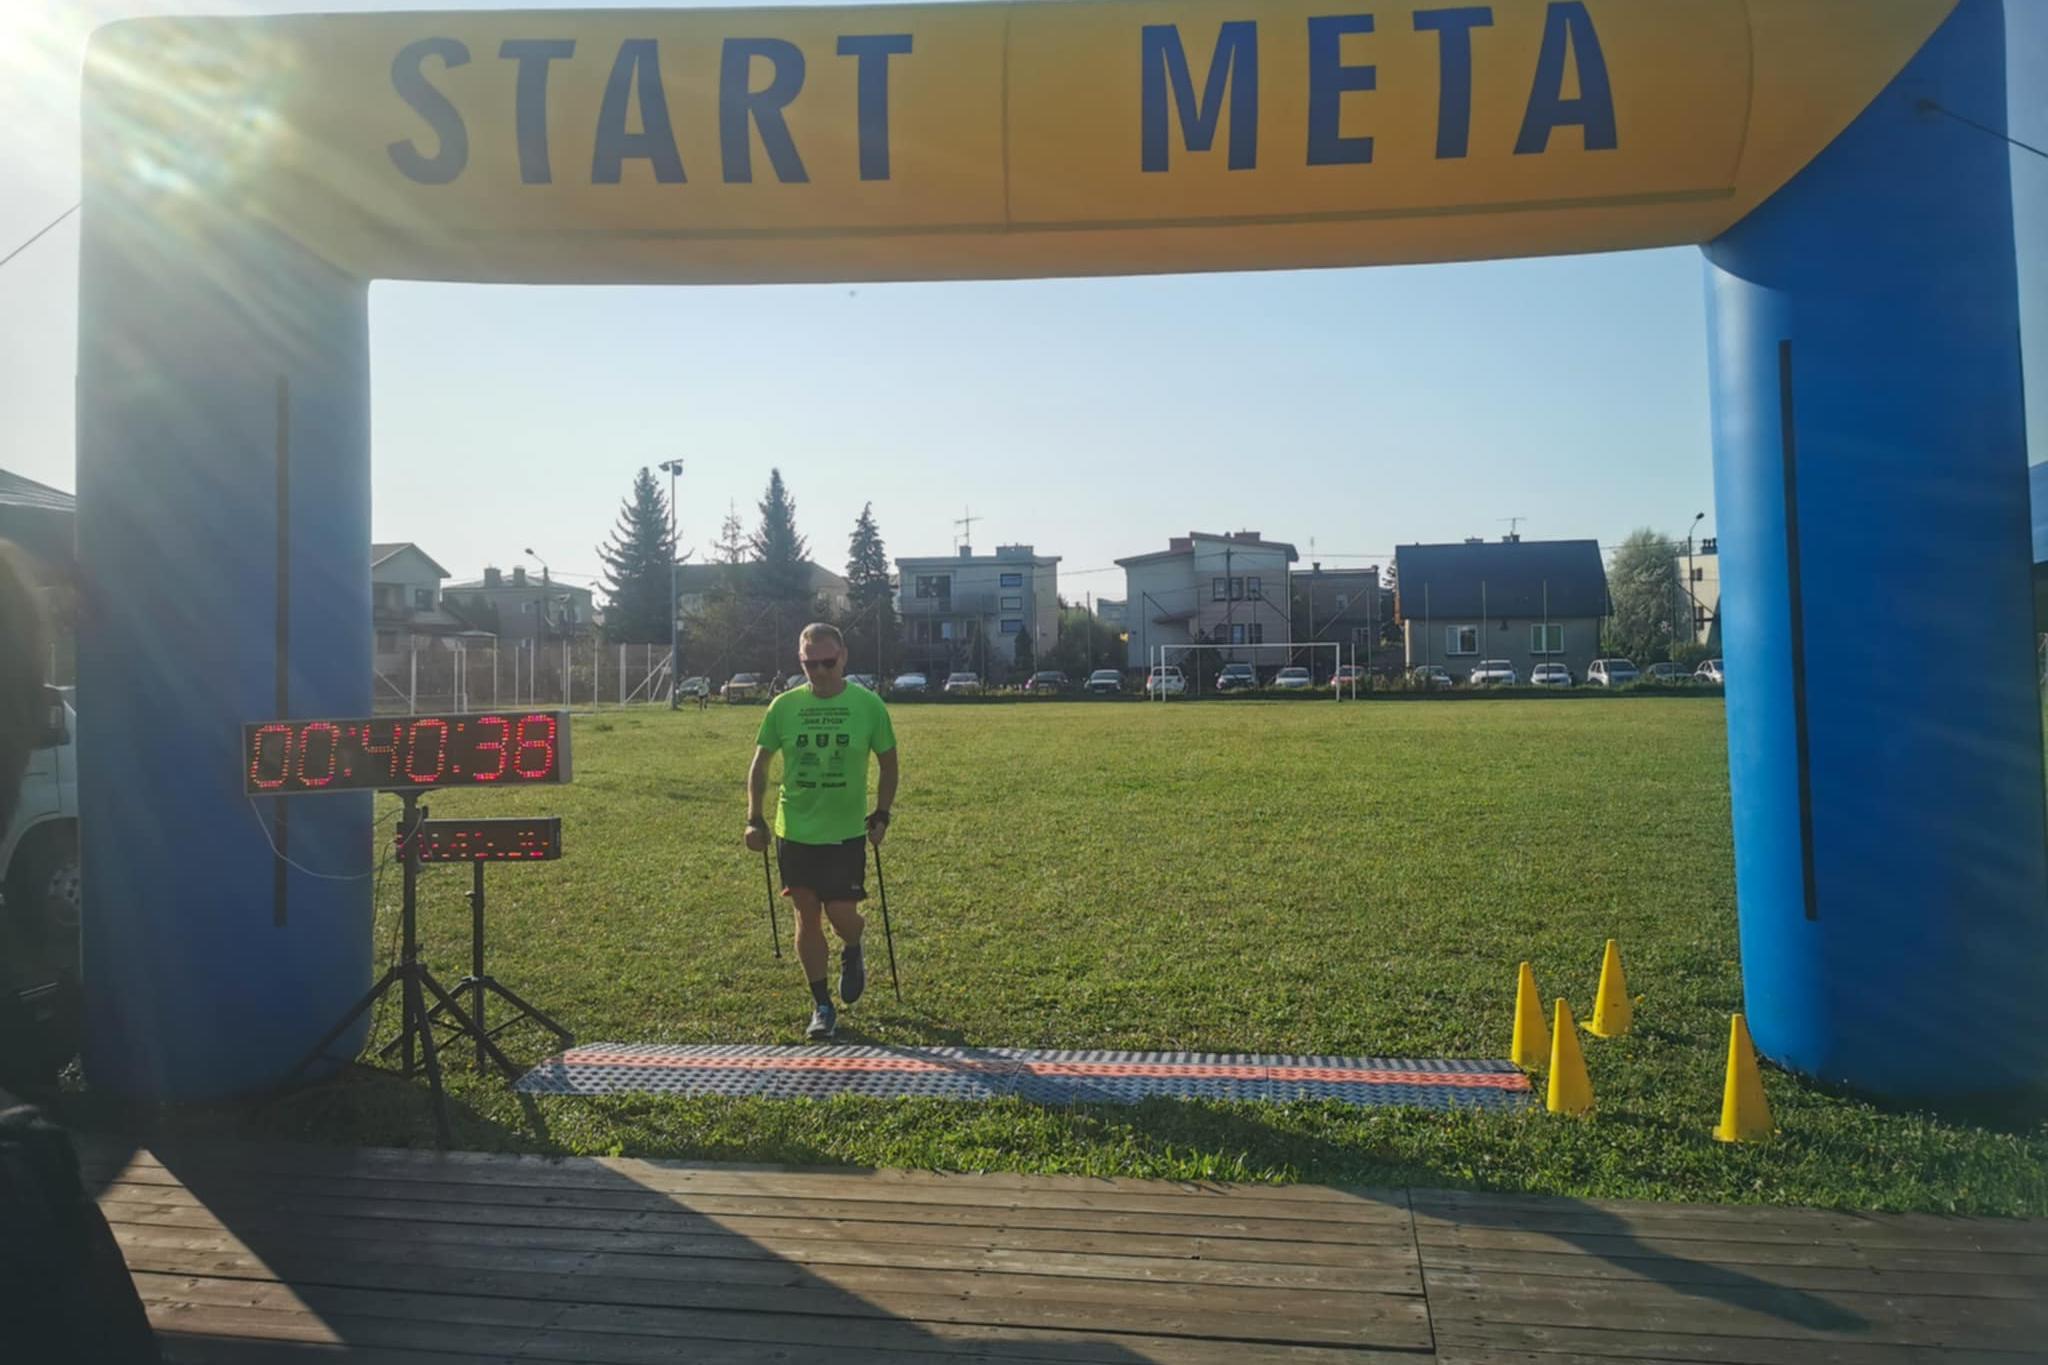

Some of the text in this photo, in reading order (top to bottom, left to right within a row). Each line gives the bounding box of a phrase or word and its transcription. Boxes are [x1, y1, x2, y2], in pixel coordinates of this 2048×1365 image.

[386, 0, 1619, 186] START META
[250, 714, 556, 788] 00:40:38
